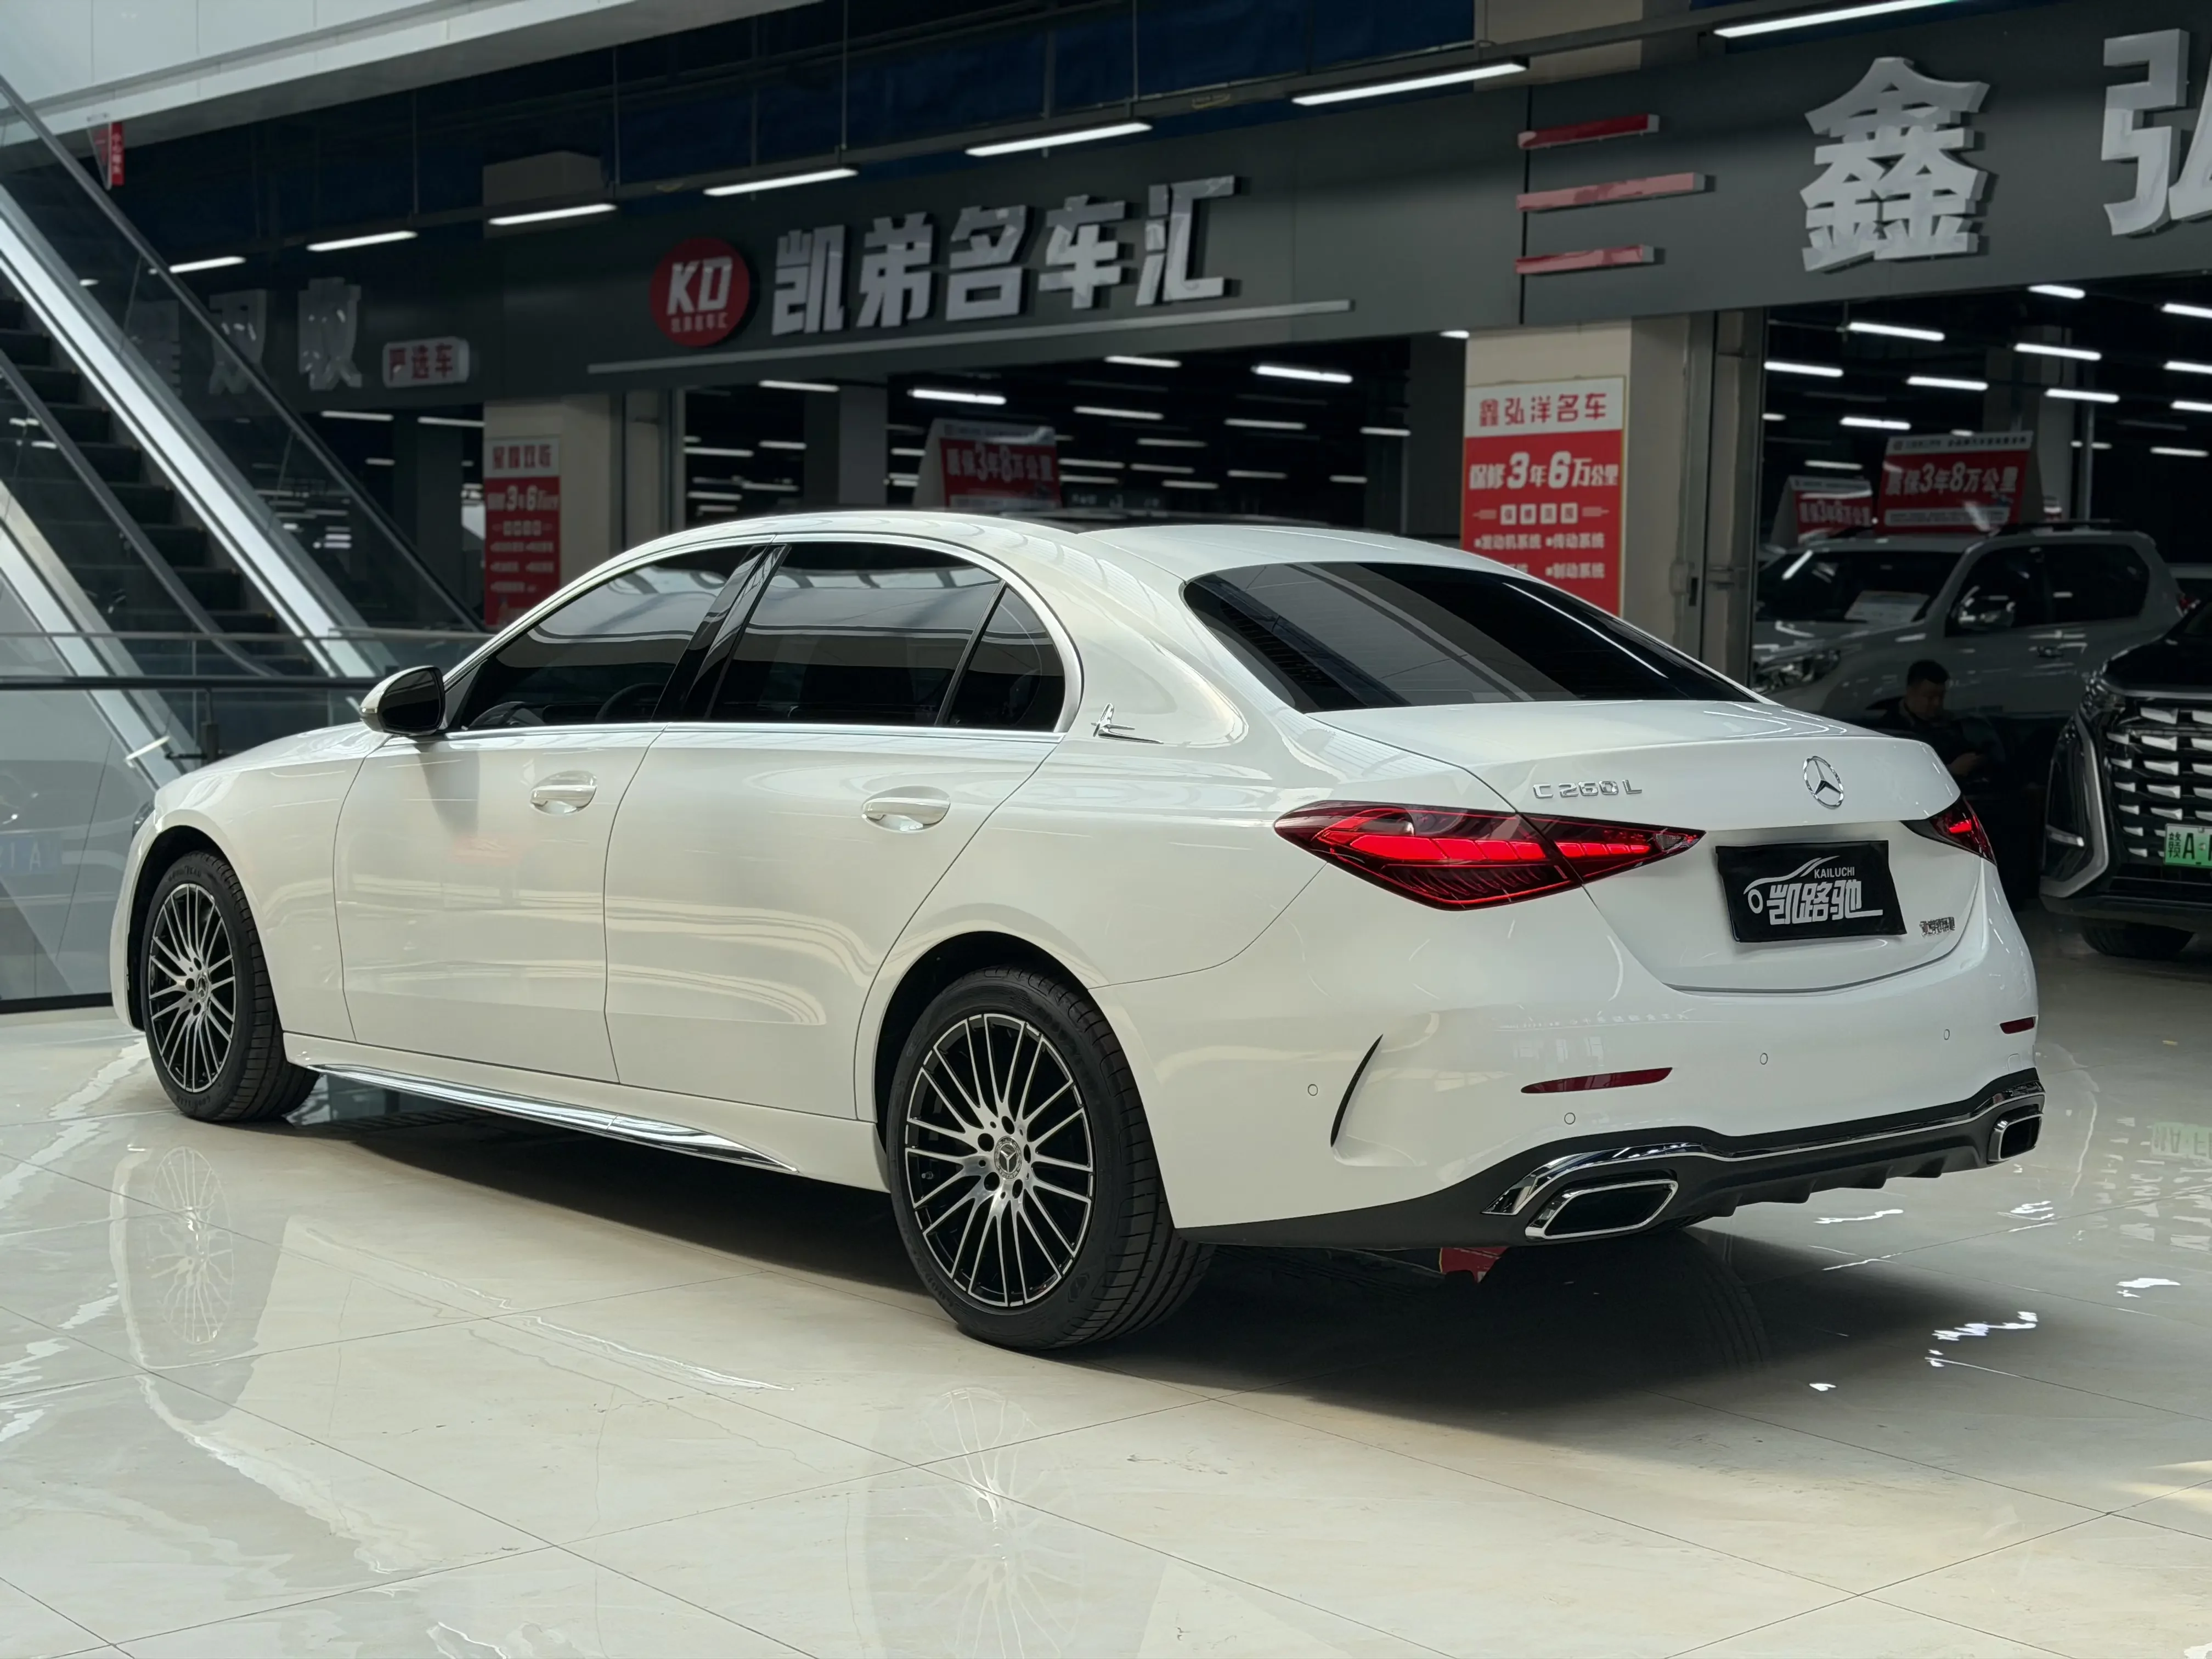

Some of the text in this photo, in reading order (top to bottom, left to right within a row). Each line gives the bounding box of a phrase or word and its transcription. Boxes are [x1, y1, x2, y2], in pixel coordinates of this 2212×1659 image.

[771, 176, 1235, 336] 凯弟名车汇
[667, 255, 733, 316] KD
[1479, 393, 1607, 427] 鑫弘洋名车
[1469, 450, 1618, 490] 保修3年6万公里
[1532, 779, 1643, 799] C 260 L
[1814, 866, 1855, 879] KAILUCHI
[1766, 879, 1883, 926] 凯路驰
